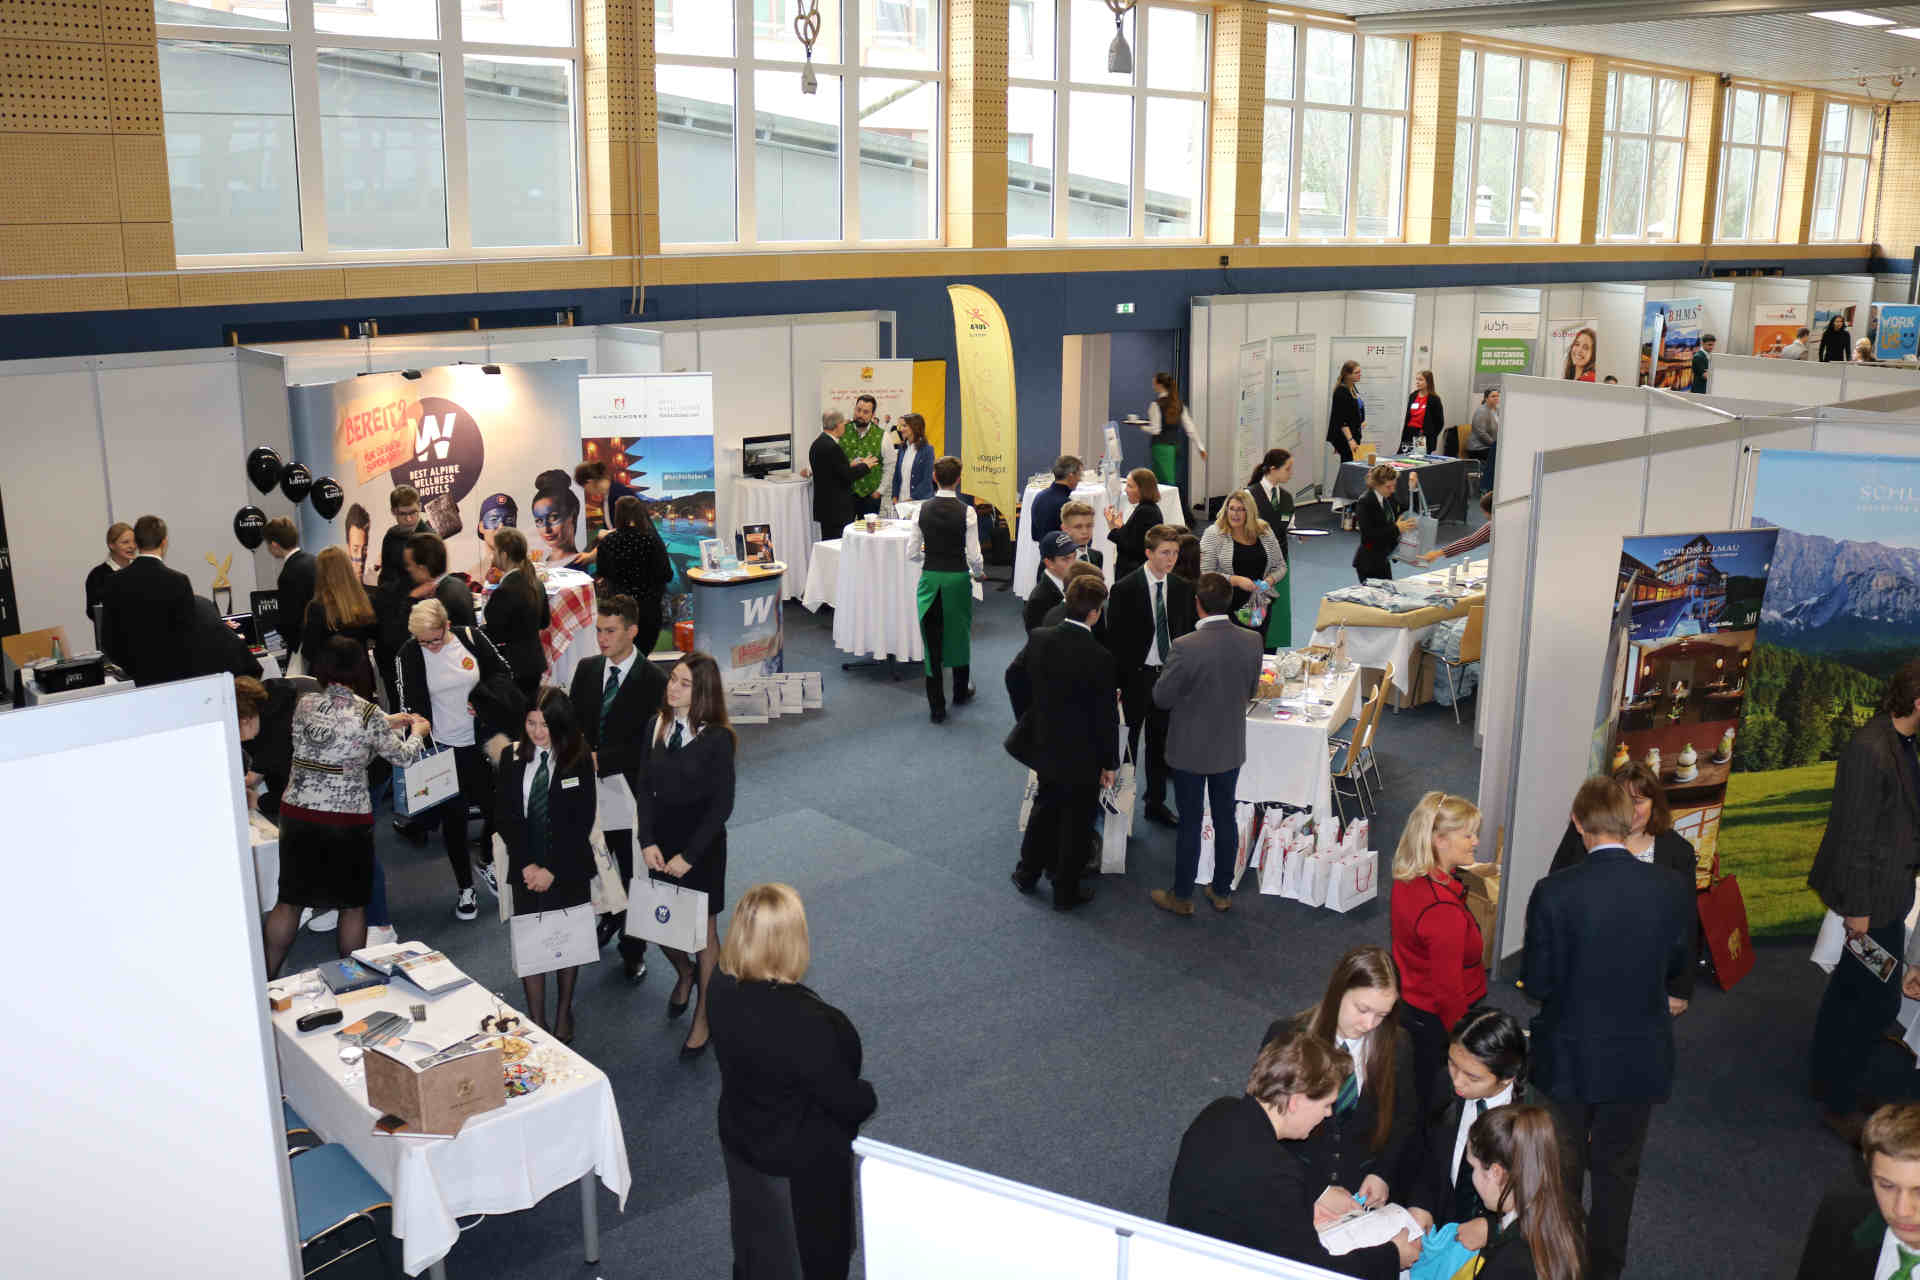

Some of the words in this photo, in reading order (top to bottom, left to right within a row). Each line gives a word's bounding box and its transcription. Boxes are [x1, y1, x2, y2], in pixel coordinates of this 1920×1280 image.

[409, 468, 428, 481] BEST
[430, 464, 460, 478] ALPINE
[414, 474, 455, 489] WELLNESS
[420, 484, 450, 497] HOTELS
[1705, 543, 1741, 554] ELMAU
[740, 593, 776, 627] W
